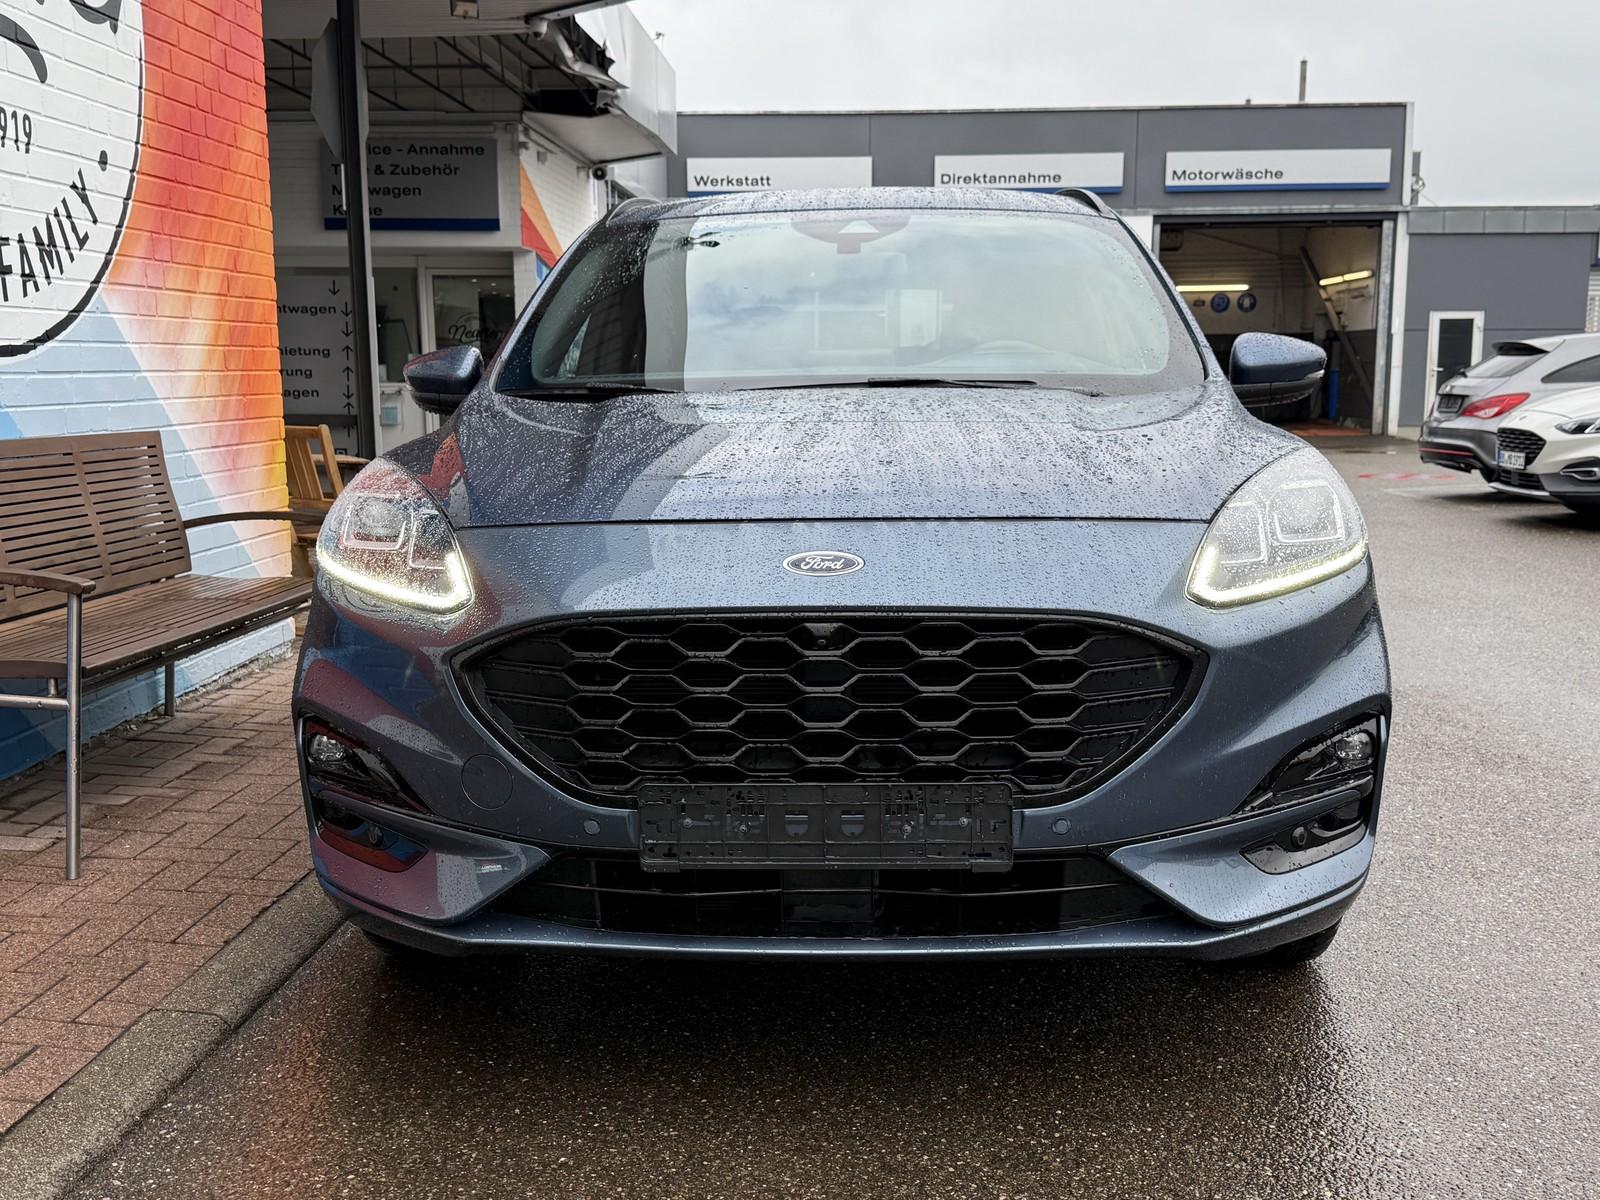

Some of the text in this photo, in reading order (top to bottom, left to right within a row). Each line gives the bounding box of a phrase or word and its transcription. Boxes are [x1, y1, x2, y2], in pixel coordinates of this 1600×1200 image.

[406, 143, 485, 156] Annahme
[373, 163, 385, 176] &
[389, 163, 461, 176] Zubehör
[1171, 168, 1285, 182] Motorwäsche
[693, 175, 772, 187] Werkstatt
[940, 172, 1062, 185] Direktannahme
[0, 168, 98, 302] FAMILY
[800, 555, 845, 570] Ford
